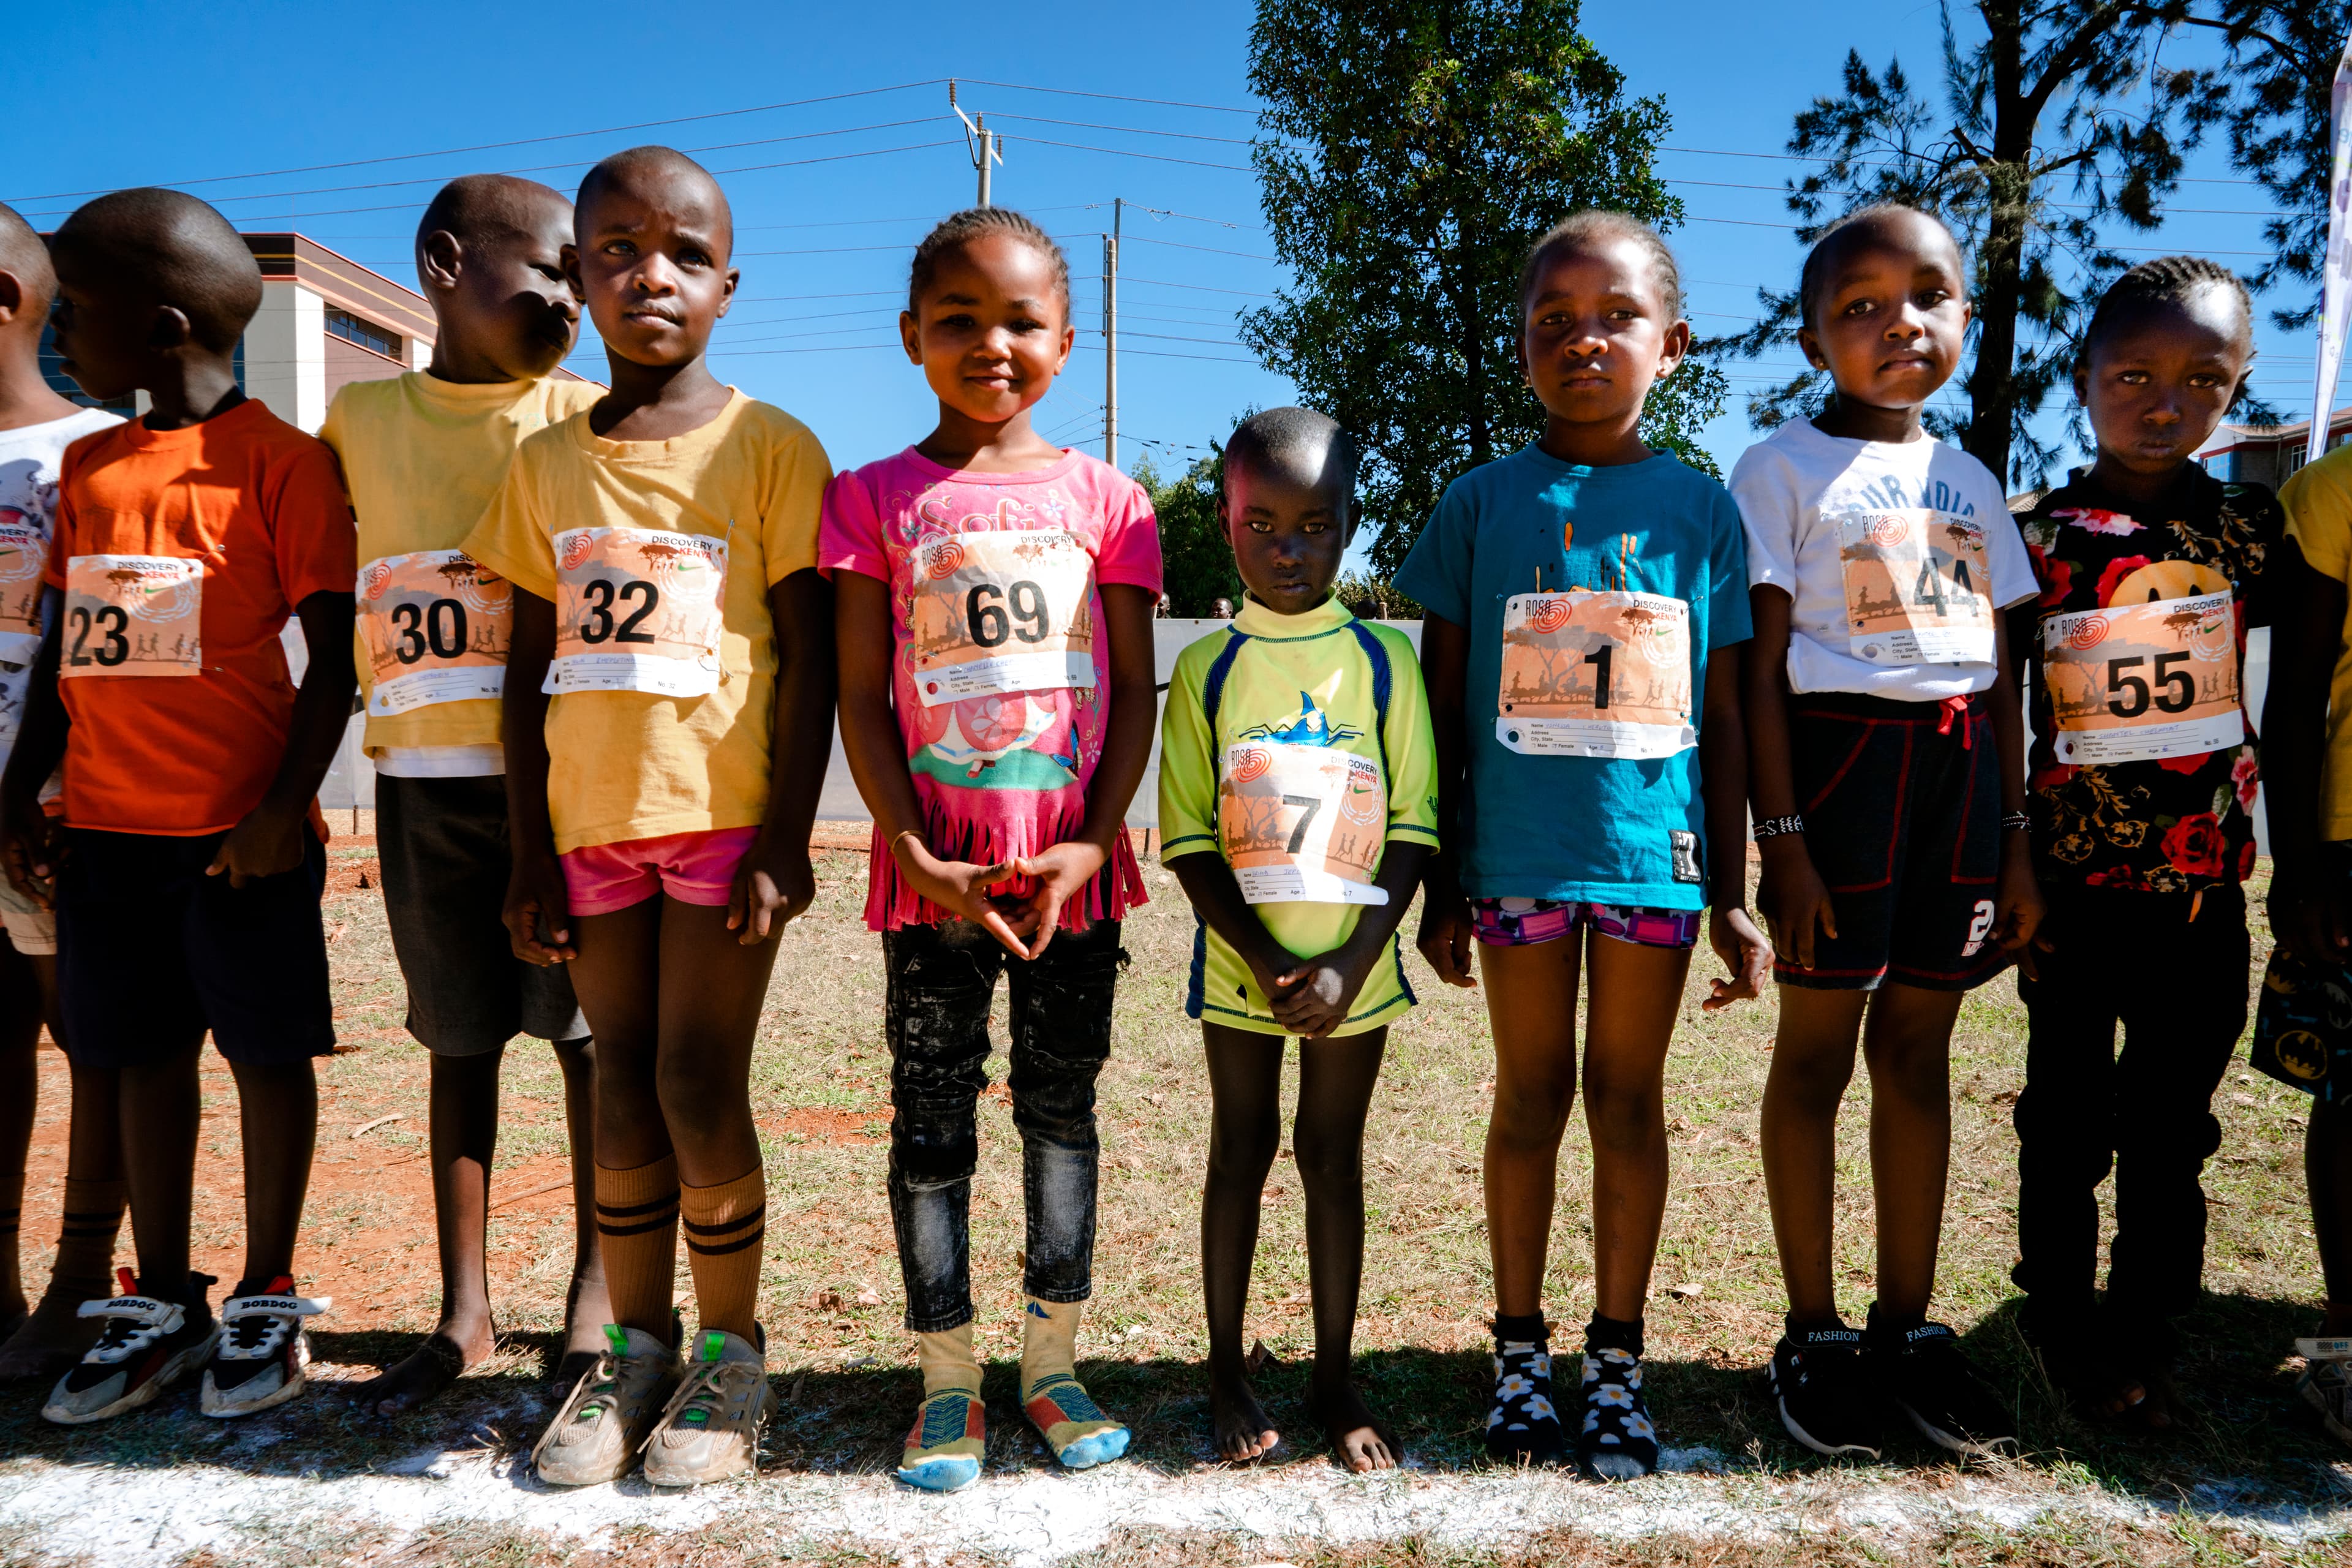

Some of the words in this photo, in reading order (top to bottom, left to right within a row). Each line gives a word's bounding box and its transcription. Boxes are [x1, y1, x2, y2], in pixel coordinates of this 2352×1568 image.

[918, 495, 1063, 544] Sofi
[652, 535, 712, 551] DISCOVERY
[1020, 534, 1072, 544] DISCOVERY
[679, 547, 712, 560] KENYA
[922, 545, 942, 567] ROSA
[117, 561, 180, 571] DISCOVERY
[145, 571, 180, 579] KENYA
[1913, 557, 1980, 618] 44
[580, 579, 659, 644] 32
[965, 580, 1049, 649] 69
[1526, 600, 1551, 617] ROSA
[1633, 599, 1676, 612] DISCOVERY
[2174, 599, 2225, 613] DISCOVERY
[1655, 612, 1678, 622] KENYA
[2062, 617, 2087, 636] ROSA
[70, 606, 129, 667] 23
[391, 598, 468, 665] 30
[1584, 645, 1612, 710] 1
[2108, 650, 2195, 718] 55
[1231, 748, 1251, 767] ROSA
[1331, 756, 1377, 775] DISCOVERY
[1354, 769, 1378, 785] KENYA
[1283, 794, 1321, 854] 7
[1766, 814, 1804, 836] SHA
[1968, 898, 1995, 941] 2
[106, 1299, 157, 1311] BOBDOG
[241, 1299, 298, 1310] BOBDOG
[1808, 1331, 1860, 1343] FASHION
[1905, 1325, 1948, 1343] FASHION
